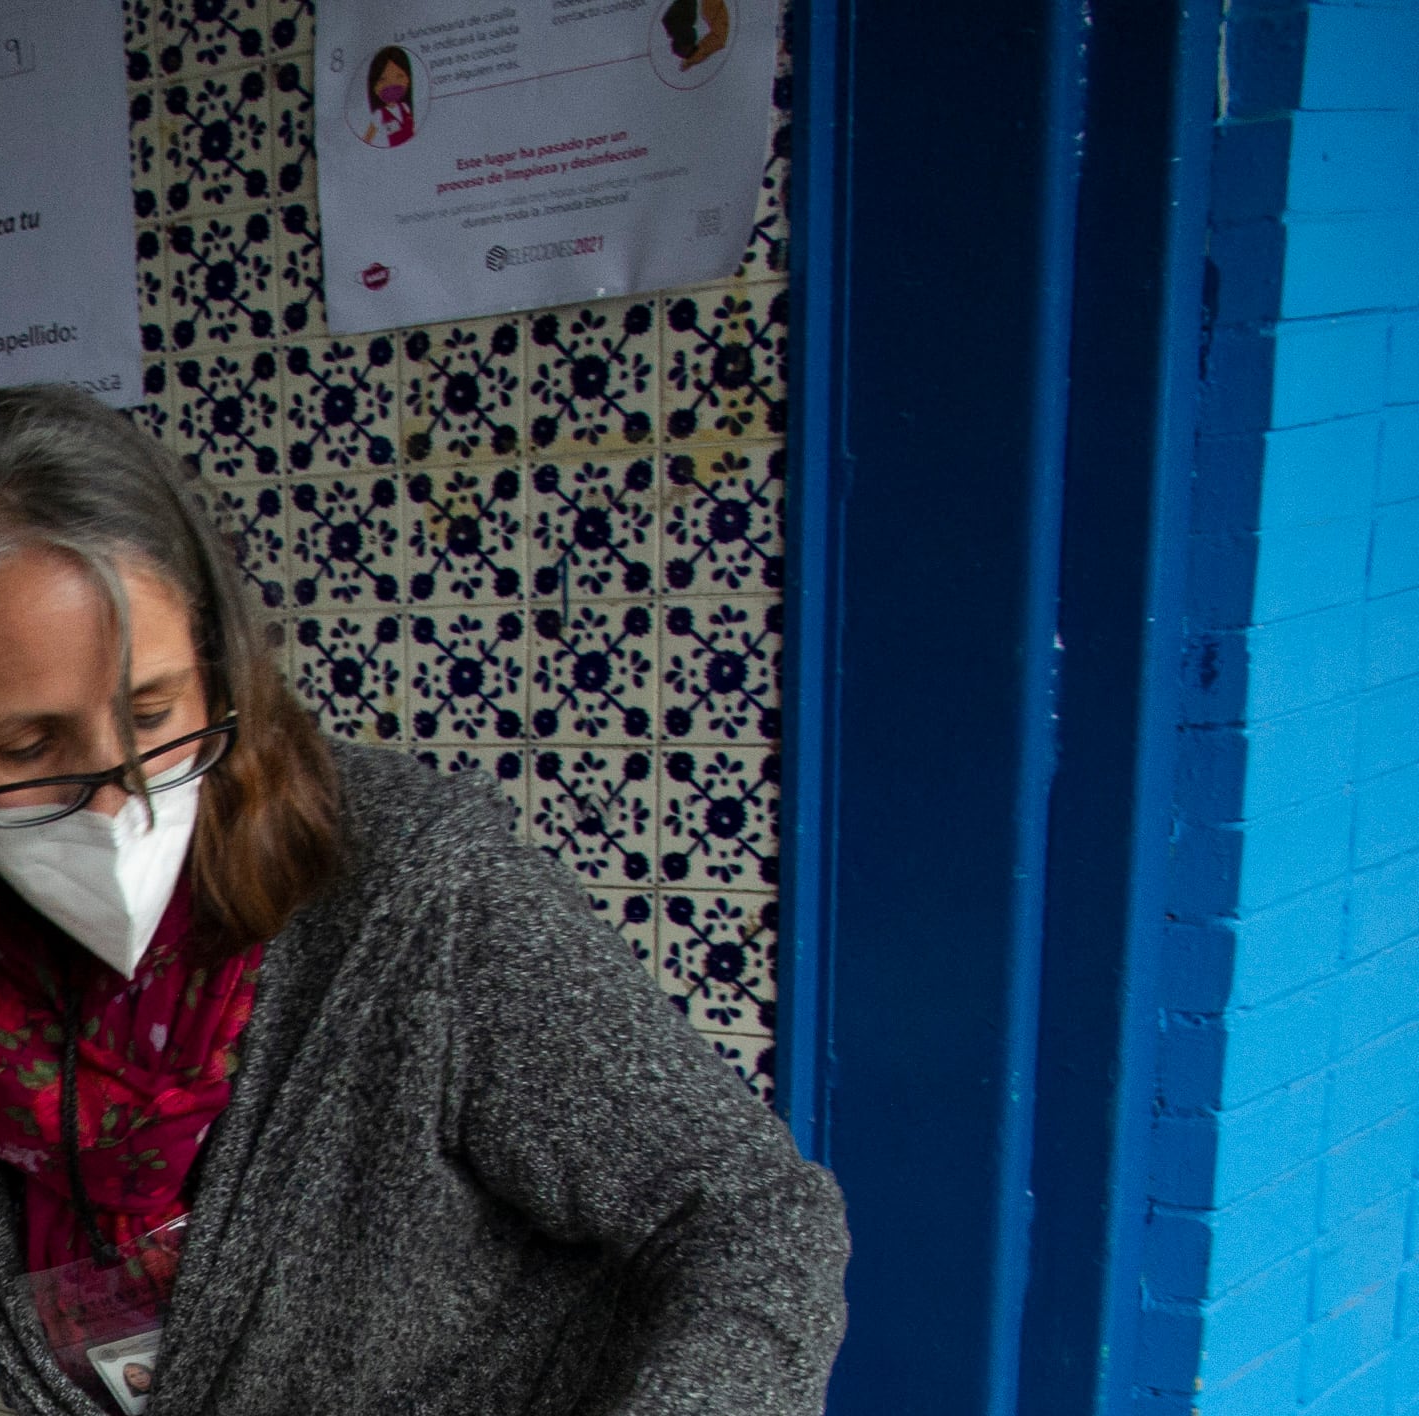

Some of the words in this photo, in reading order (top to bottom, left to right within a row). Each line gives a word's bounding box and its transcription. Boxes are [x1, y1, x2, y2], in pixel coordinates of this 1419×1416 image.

[436, 174, 484, 196] proceso
[487, 169, 502, 184] de
[505, 158, 557, 183] limpieza
[571, 139, 650, 170] desinfección
[456, 153, 483, 172] Este
[485, 147, 516, 170] lugar
[519, 144, 534, 160] ha
[537, 135, 583, 160] pasado
[585, 131, 607, 150] por
[609, 129, 627, 143] un
[15, 209, 41, 231] tu
